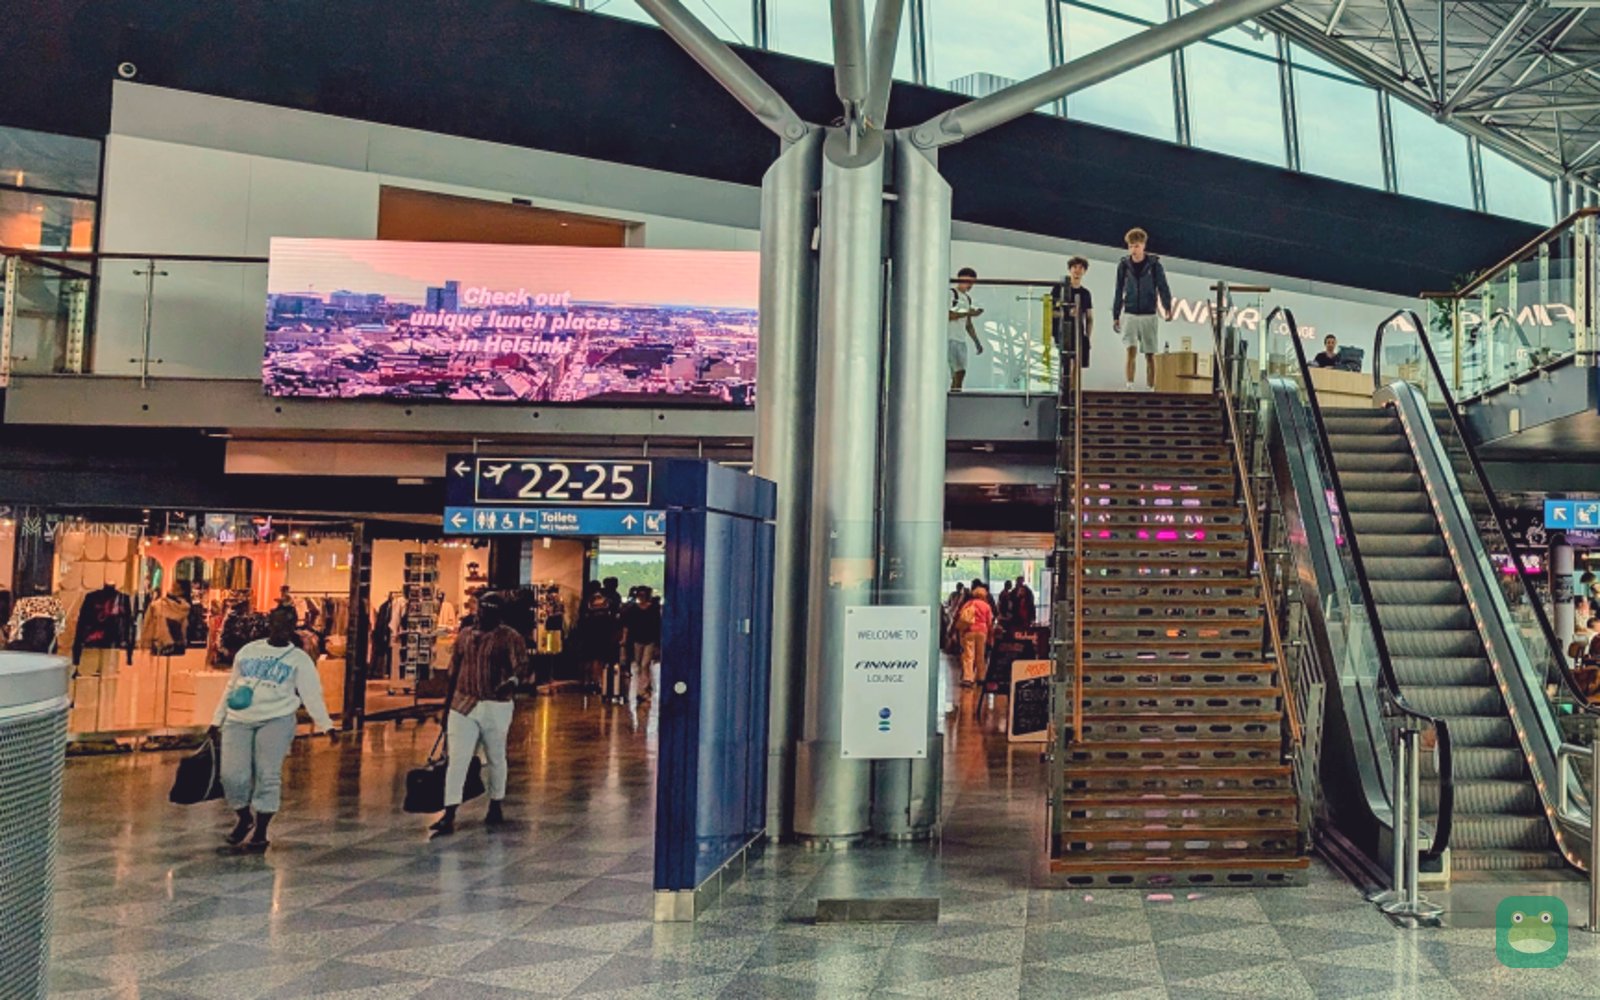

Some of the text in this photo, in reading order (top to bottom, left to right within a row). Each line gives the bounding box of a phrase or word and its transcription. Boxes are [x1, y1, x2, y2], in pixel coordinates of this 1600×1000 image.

[463, 288, 571, 306] Check out
[410, 309, 621, 332] unique lunch places
[458, 335, 574, 354] in Helsinki
[518, 463, 634, 500] 22-25
[541, 511, 578, 524] Toilets
[857, 630, 918, 640] WELCOME TO
[854, 660, 919, 669] FINNAIR
[866, 674, 904, 683] LOUNGE
